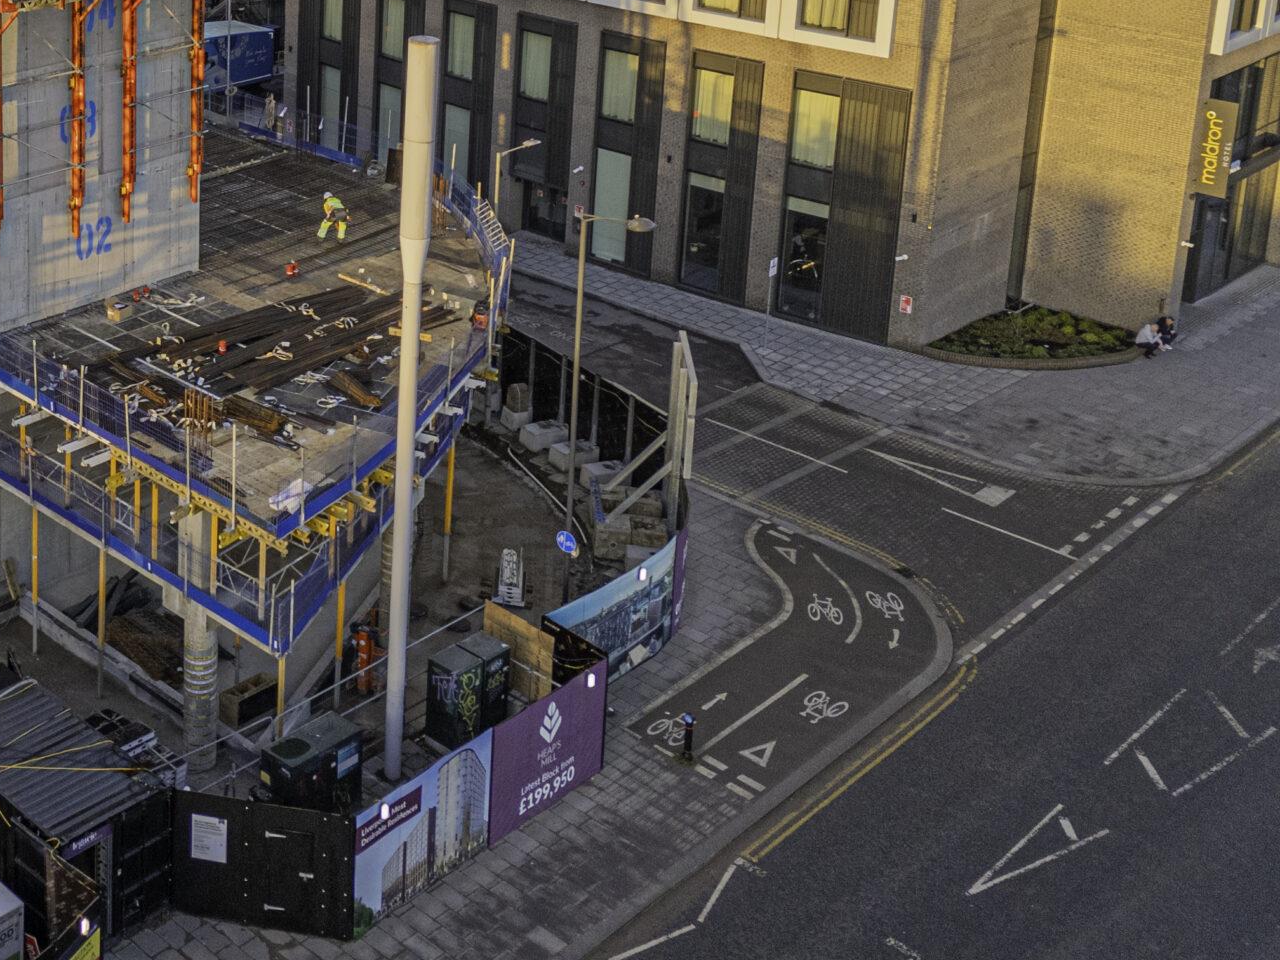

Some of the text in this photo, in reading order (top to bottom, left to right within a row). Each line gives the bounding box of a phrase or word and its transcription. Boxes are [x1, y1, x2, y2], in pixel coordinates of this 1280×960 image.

[1200, 119, 1225, 186] maldron
[1221, 141, 1233, 168] HOTEL
[75, 215, 114, 261] 02
[518, 765, 576, 816] £199,950
[520, 777, 541, 796] Latest
[541, 765, 560, 783] Block
